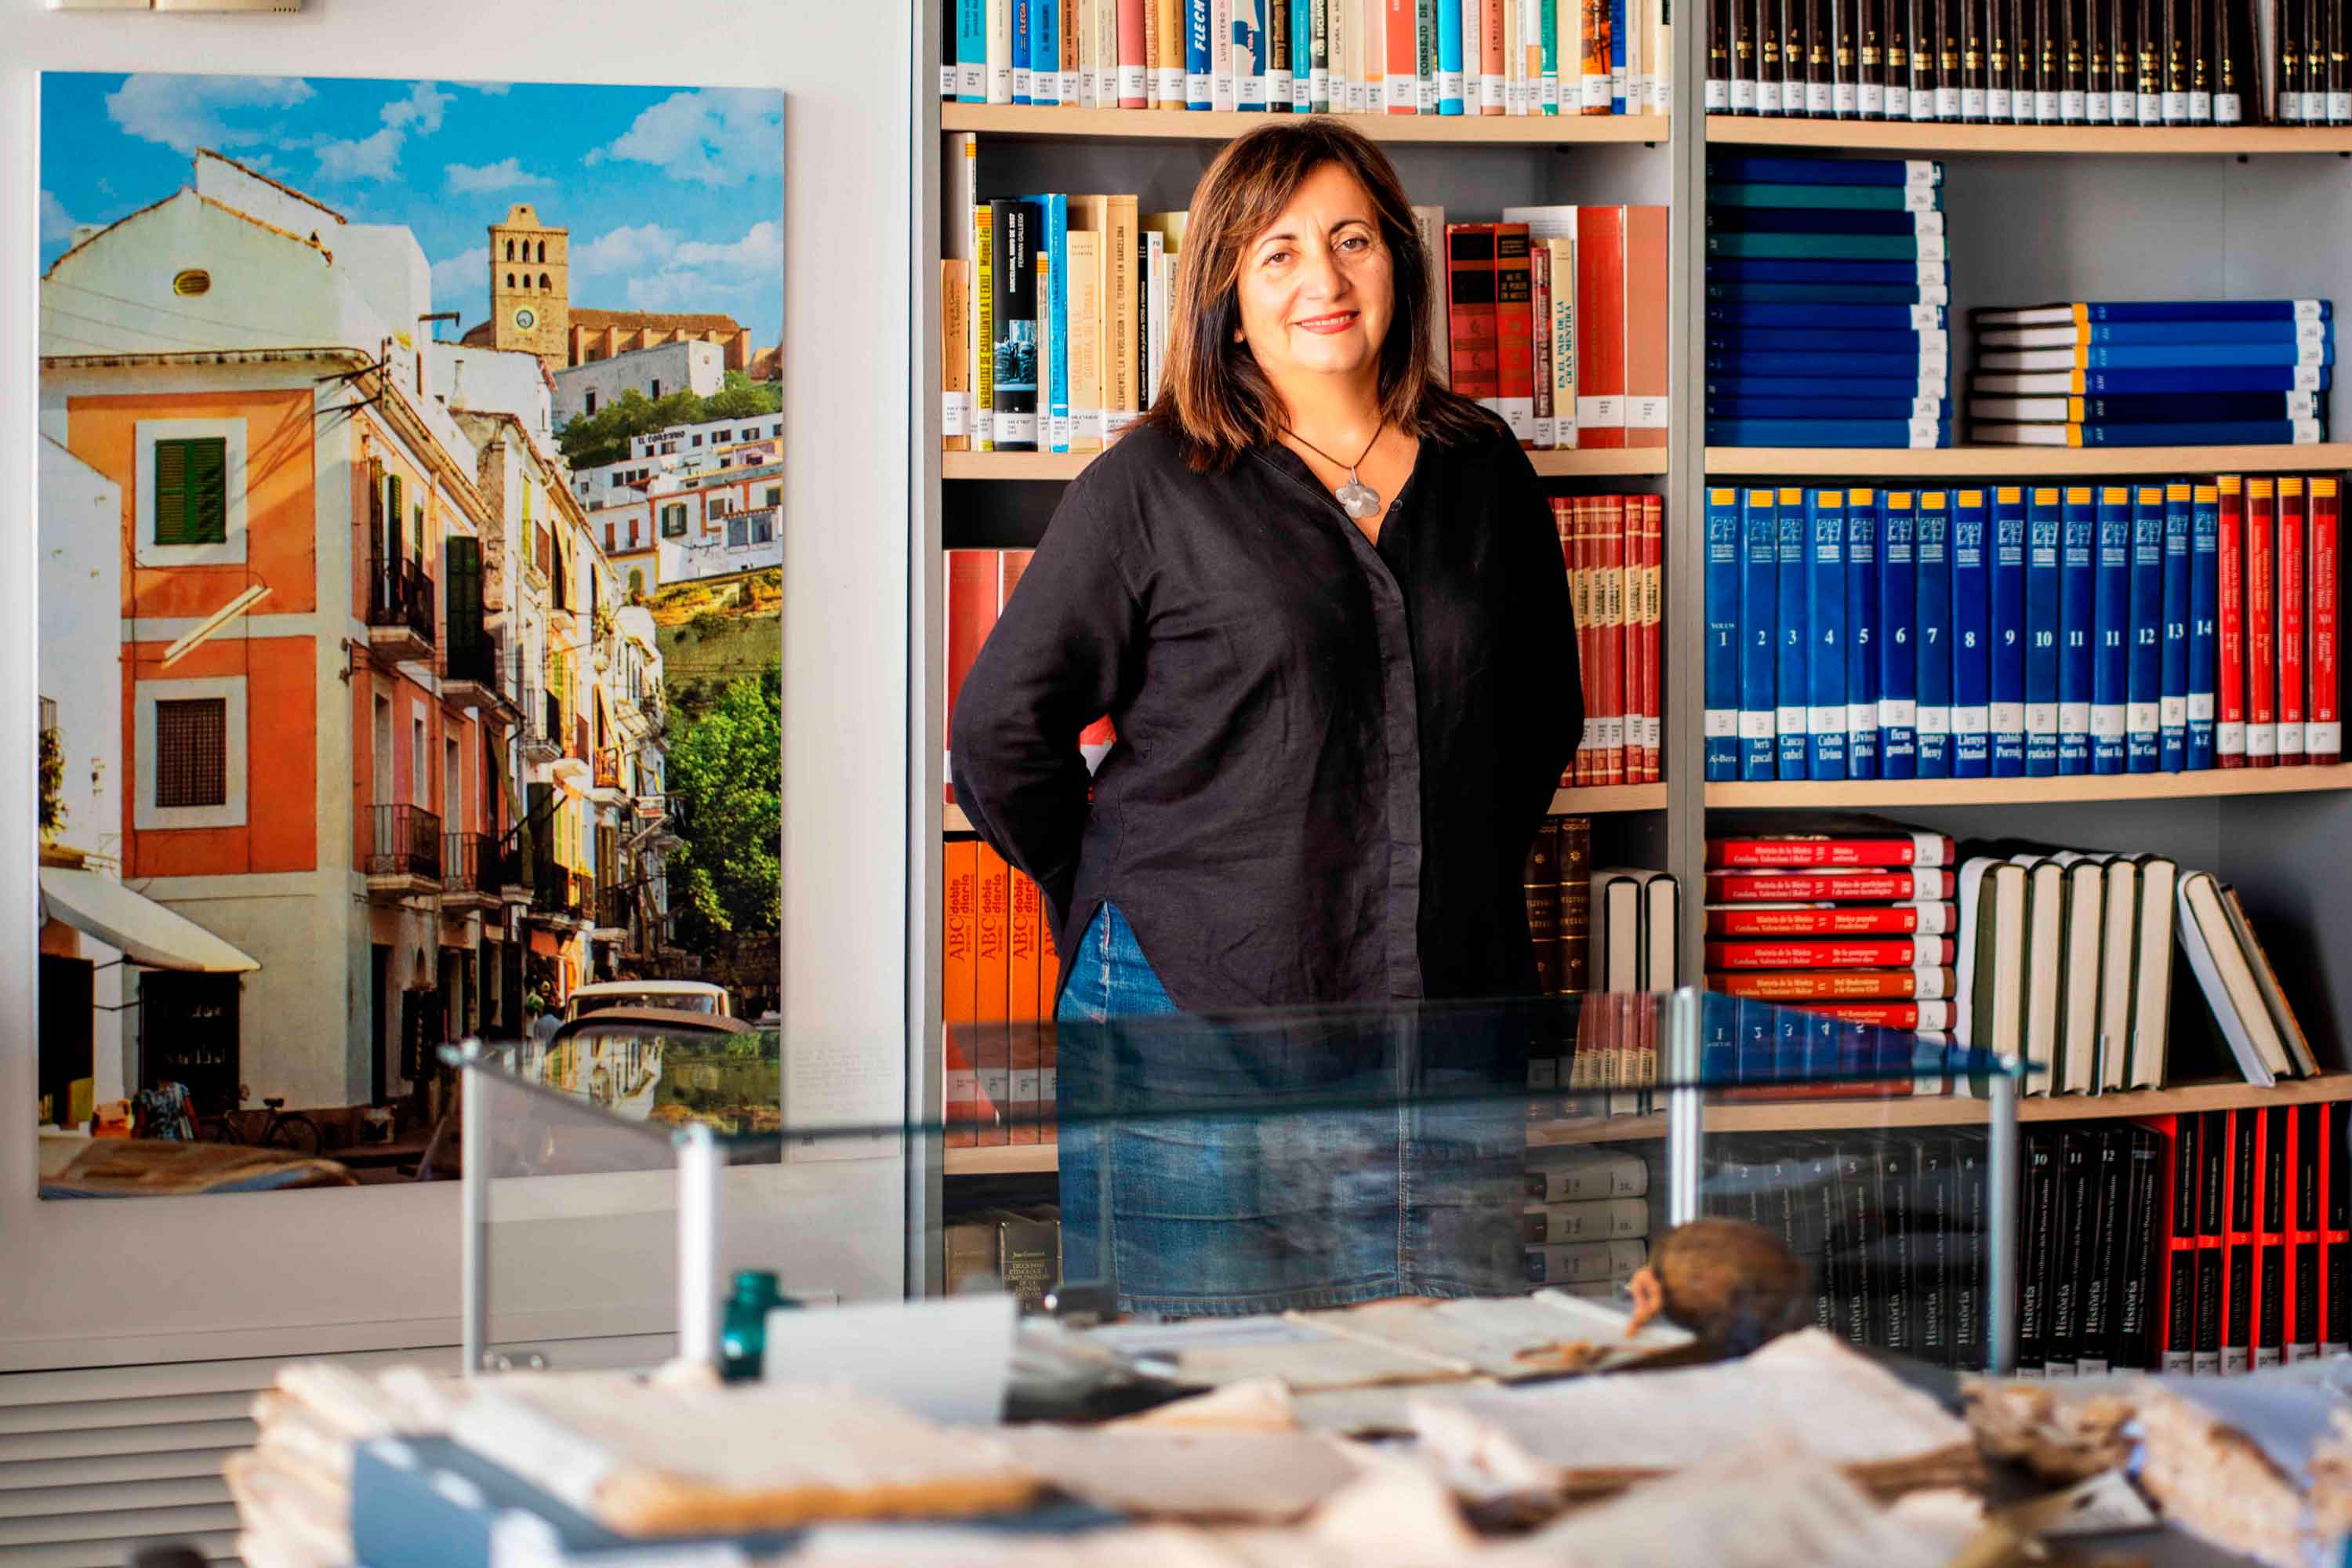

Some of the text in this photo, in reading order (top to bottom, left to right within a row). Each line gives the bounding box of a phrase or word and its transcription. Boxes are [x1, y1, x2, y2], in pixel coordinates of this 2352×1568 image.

[1420, 4, 1430, 76] CONSEJO DE
[1116, 264, 1124, 273] EN
[1556, 301, 1564, 314] LA
[980, 309, 991, 352] CATALUNYA
[1557, 318, 1565, 331] DE
[1564, 305, 1573, 351] MENTIRA
[1557, 360, 1565, 372] EL
[980, 367, 992, 408] ENERALITAT
[1557, 375, 1566, 389] EN
[1824, 629, 1835, 644] 4
[1858, 629, 1869, 644] 5
[1896, 627, 1906, 643] 6
[1927, 627, 1938, 644] 7
[2138, 628, 2155, 644] 12
[2167, 622, 2184, 640] 13
[2196, 619, 2213, 637] 14
[1721, 632, 1728, 648] 1
[1758, 630, 1766, 646] 2
[1788, 630, 1797, 644] 3
[1965, 632, 1976, 648] 8
[2005, 629, 2015, 645] 9
[2035, 630, 2053, 647] 10
[2070, 630, 2084, 647] 11
[2106, 630, 2120, 647] 11
[949, 878, 960, 914] doble
[961, 873, 971, 914] diario
[982, 878, 992, 914] doble
[993, 873, 1002, 914] diario
[1014, 878, 1023, 913] doble
[949, 916, 964, 963] ABC
[981, 916, 996, 960] ABC
[1013, 916, 1028, 960] ABC
[2032, 1152, 2048, 1166] 10
[2070, 1152, 2082, 1164] 11
[2102, 1149, 2115, 1163] 12
[1741, 1167, 1748, 1178] 2
[1774, 1165, 1781, 1176] 3
[1813, 1163, 1821, 1173] 4
[1849, 1162, 1857, 1173] 5
[1889, 1160, 1897, 1171] 6
[1929, 1159, 1937, 1171] 7
[2021, 1286, 2035, 1338] Història
[2055, 1284, 2070, 1337] Història
[2085, 1281, 2101, 1333] Història
[2123, 1281, 2138, 1333] Història
[1888, 1294, 1900, 1347] Història
[1926, 1293, 1937, 1345] Història
[1957, 1292, 1970, 1344] Història
